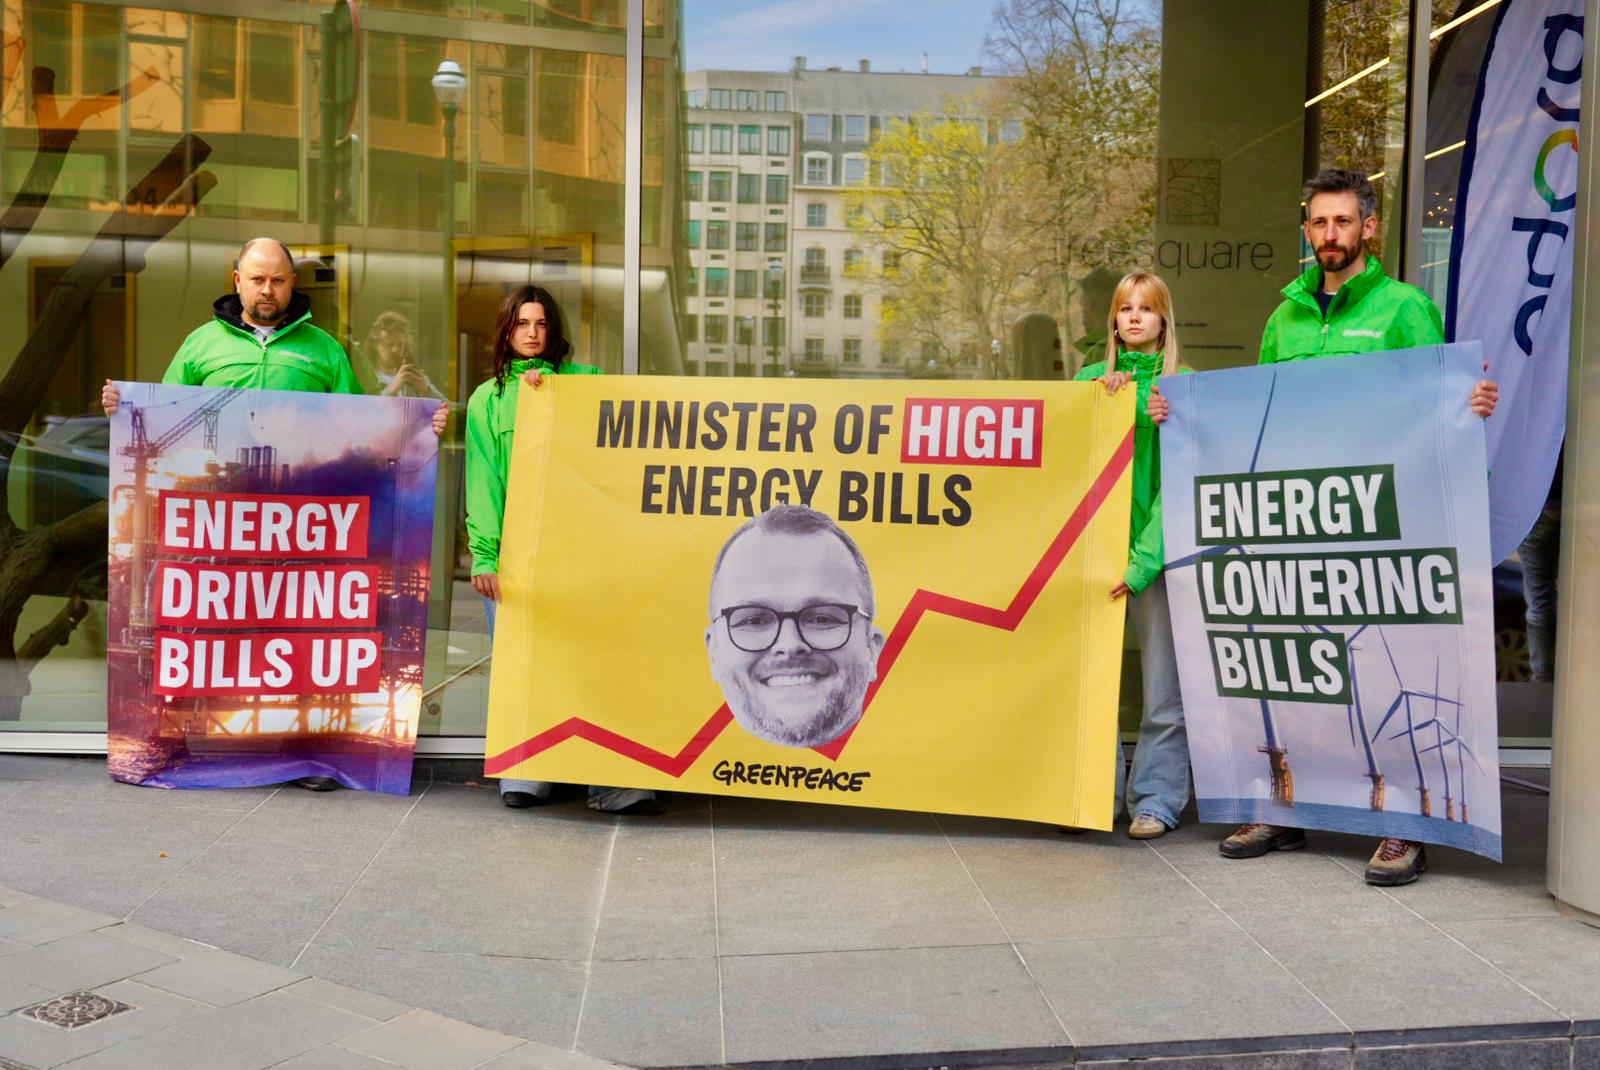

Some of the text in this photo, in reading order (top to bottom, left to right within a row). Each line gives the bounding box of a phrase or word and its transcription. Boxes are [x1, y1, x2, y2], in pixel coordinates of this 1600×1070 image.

[596, 399, 1035, 460] MINISTER OF HIGH
[164, 497, 360, 552] ENERGY
[641, 464, 973, 527] ENERGY BILLS
[1199, 473, 1384, 539] ENERGY
[161, 567, 370, 620] DRIVING
[1201, 554, 1457, 617] LOWERING
[159, 637, 377, 688] BILLS UP
[1213, 636, 1344, 696] BILLS
[712, 760, 871, 792] GREENPEACE
